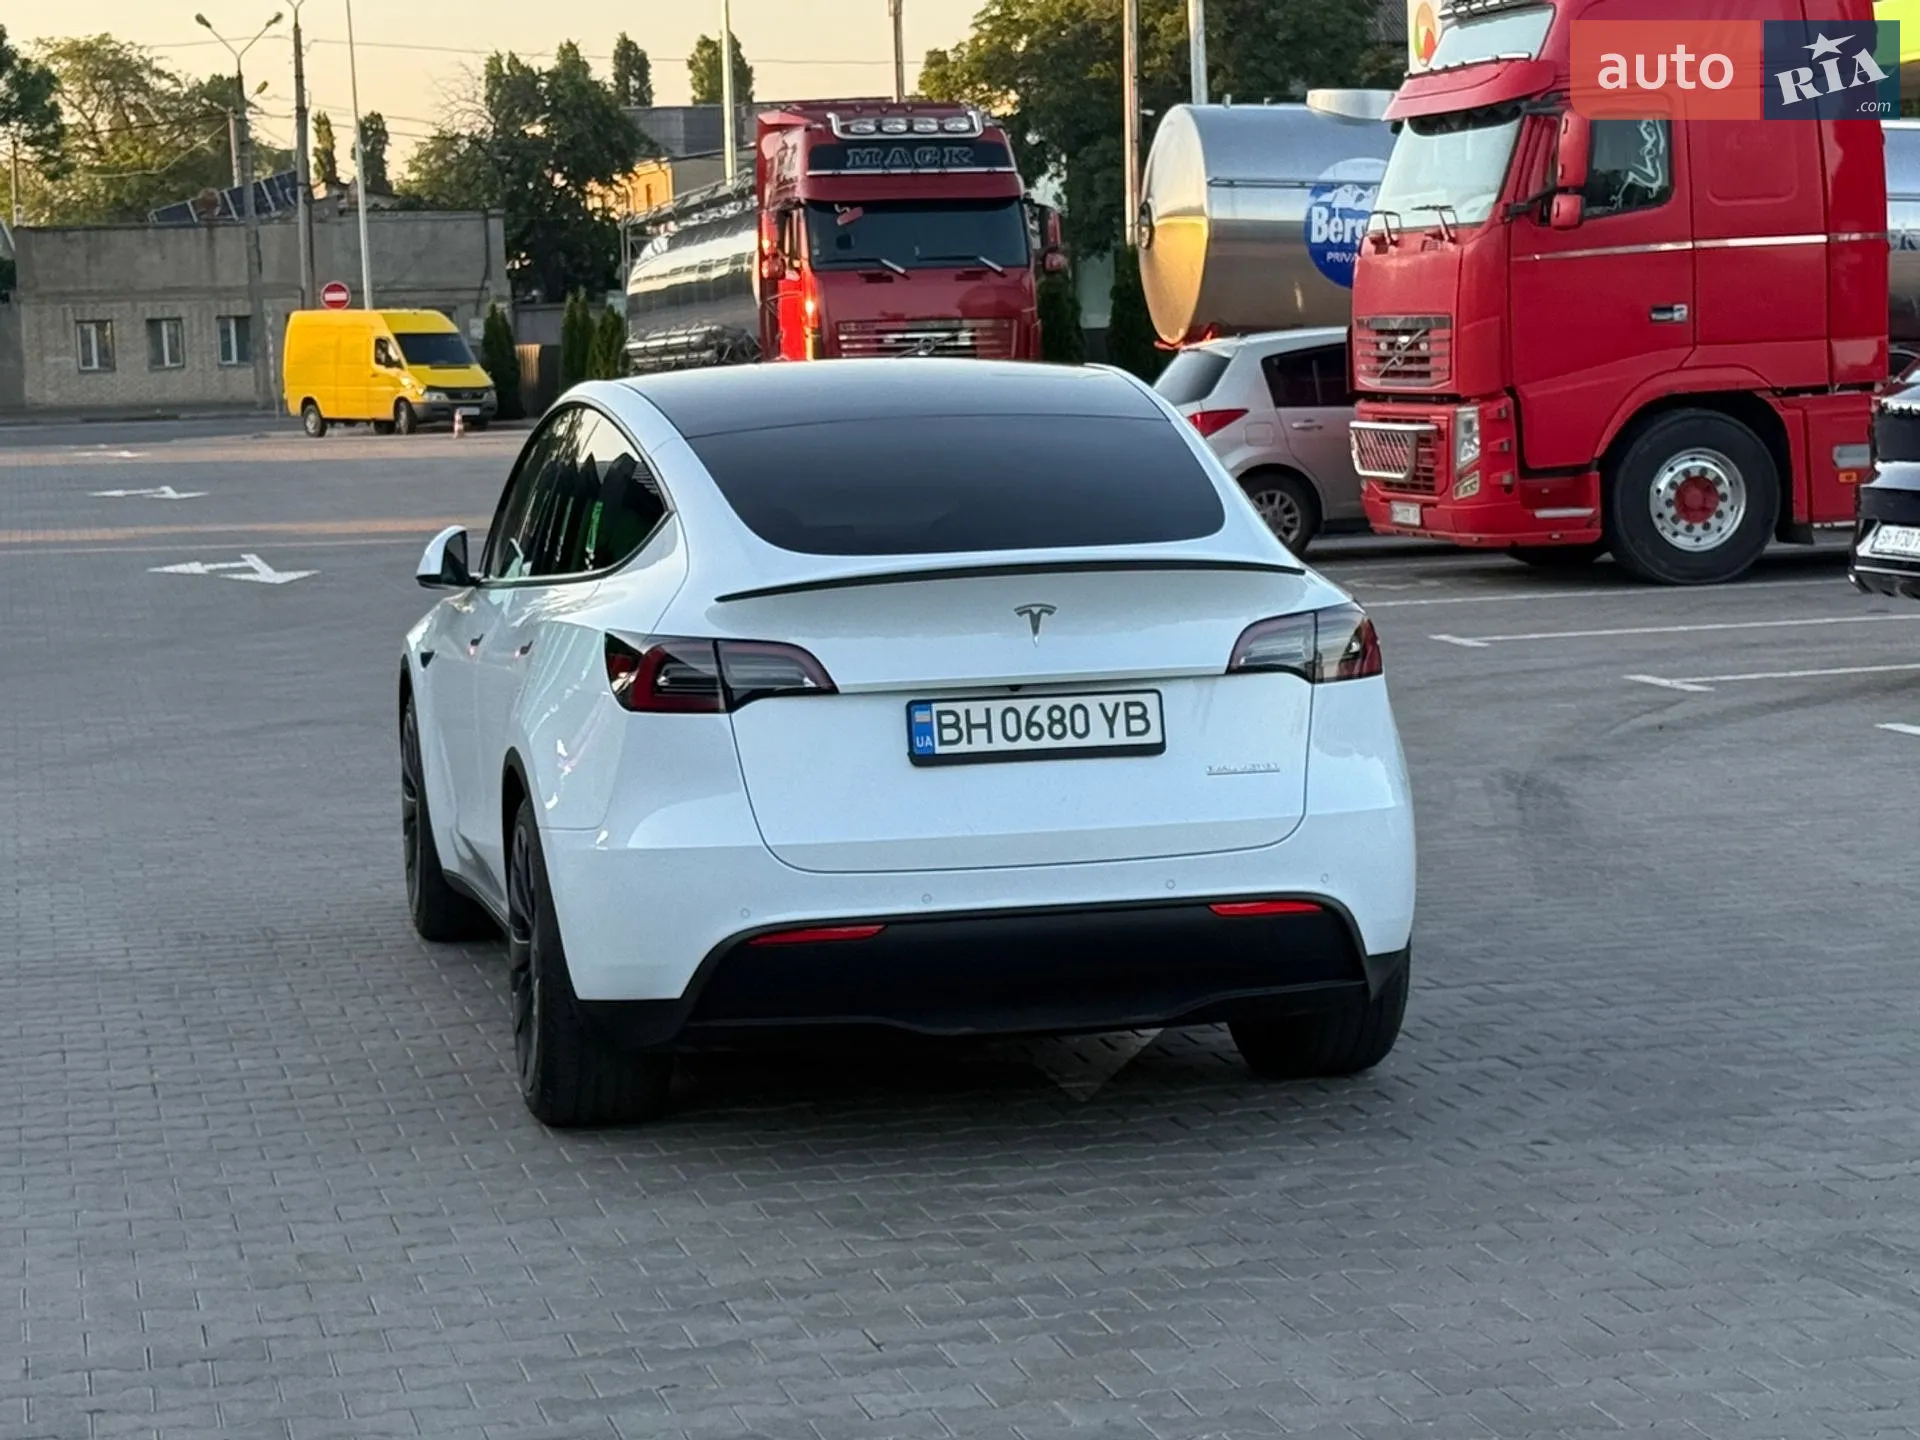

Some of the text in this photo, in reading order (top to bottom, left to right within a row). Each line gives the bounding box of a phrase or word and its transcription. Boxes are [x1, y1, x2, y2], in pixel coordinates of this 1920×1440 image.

[847, 147, 976, 167] MACK
[936, 701, 1151, 747] BH 0680 YB
[916, 736, 933, 748] UA
